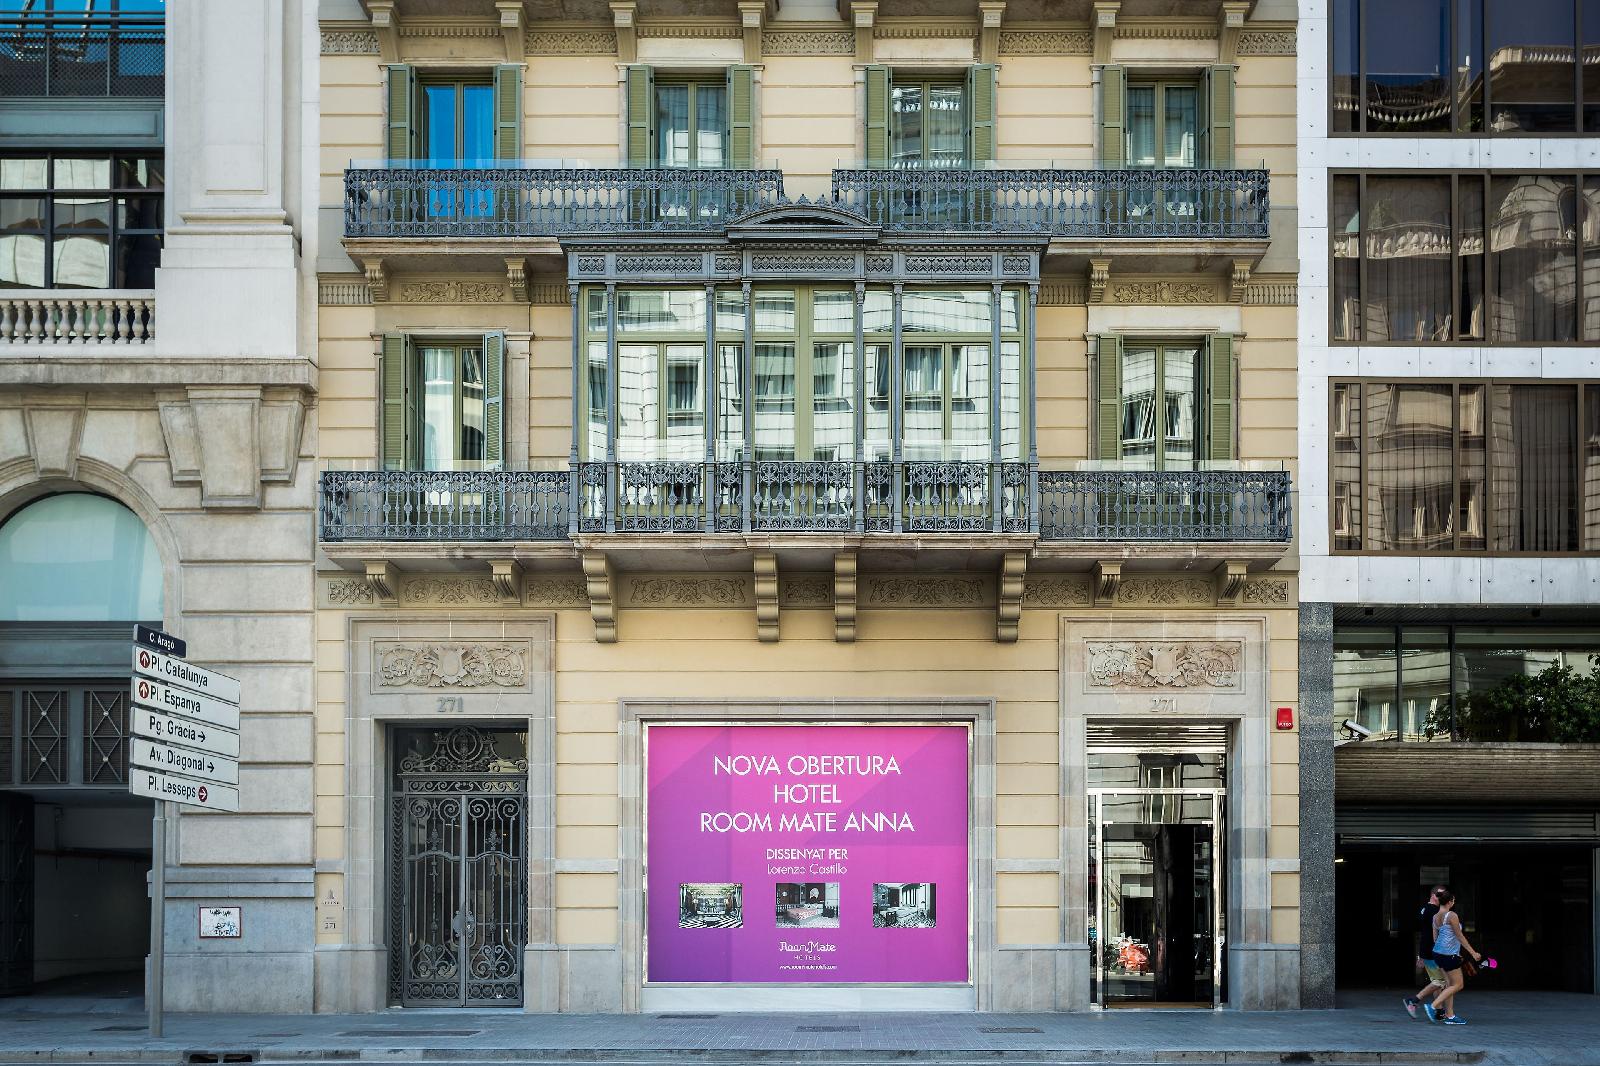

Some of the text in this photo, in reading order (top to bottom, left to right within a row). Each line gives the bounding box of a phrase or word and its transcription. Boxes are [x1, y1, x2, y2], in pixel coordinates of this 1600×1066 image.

[157, 634, 175, 651] Aragó
[151, 655, 208, 687] Pl. Catalunya
[150, 685, 201, 713] Pl. Espanya
[436, 696, 464, 713] 271
[1150, 698, 1177, 713] 271
[149, 715, 196, 741] Pg. Gràcia
[149, 746, 205, 771] Av. Diagonal
[713, 754, 902, 776] NOVA OBERTURA
[148, 775, 196, 800] Pl. Lesseps
[773, 783, 842, 804] HOTEL
[700, 811, 915, 833] ROOM MATE ANNA
[766, 848, 848, 860] DISSENYAT PER
[767, 863, 848, 875] Lorenzo Castillo
